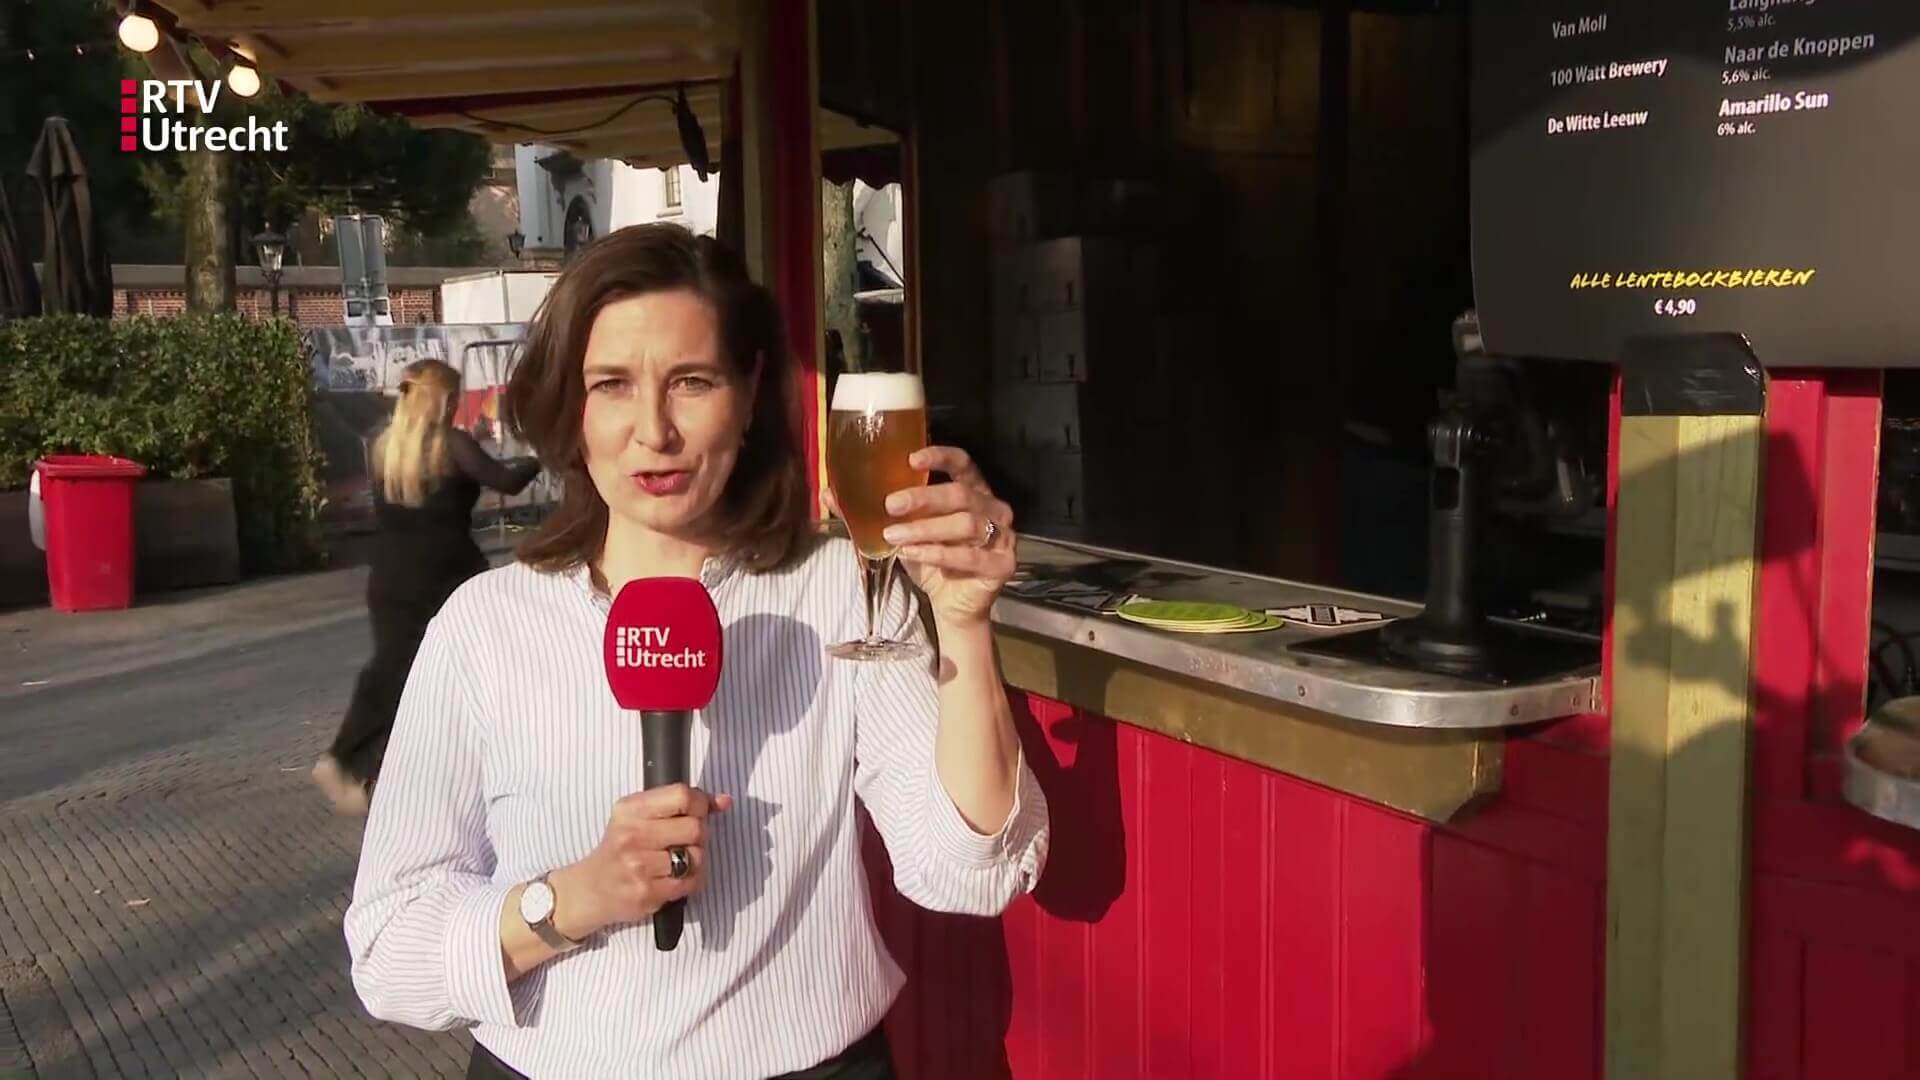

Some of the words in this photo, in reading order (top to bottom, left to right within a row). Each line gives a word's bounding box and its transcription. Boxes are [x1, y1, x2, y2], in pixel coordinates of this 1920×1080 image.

[1552, 21, 1576, 38] Van
[1578, 14, 1608, 34] Moll
[1757, 13, 1776, 27] alc.
[1724, 46, 1765, 64] Naar
[1767, 40, 1789, 59] de
[1792, 33, 1875, 57] Knoppen
[1551, 68, 1573, 87] 100
[1575, 64, 1607, 83] Watt
[1608, 58, 1668, 79] Brewery
[1721, 70, 1750, 86] 5,6%
[1752, 67, 1771, 80] alc.
[1718, 93, 1791, 117] Amarillo
[1794, 91, 1829, 110] Sun
[1547, 117, 1564, 134] De
[1565, 114, 1601, 132] Witte
[1602, 110, 1649, 129] Leeuw
[1717, 122, 1735, 136] 6%
[1737, 121, 1756, 135] alc.
[1570, 272, 1612, 289] ALLE
[1615, 269, 1816, 288] LENTEBOCKBIEREN
[627, 627, 670, 647] RTV
[626, 647, 706, 668] Utrecht
